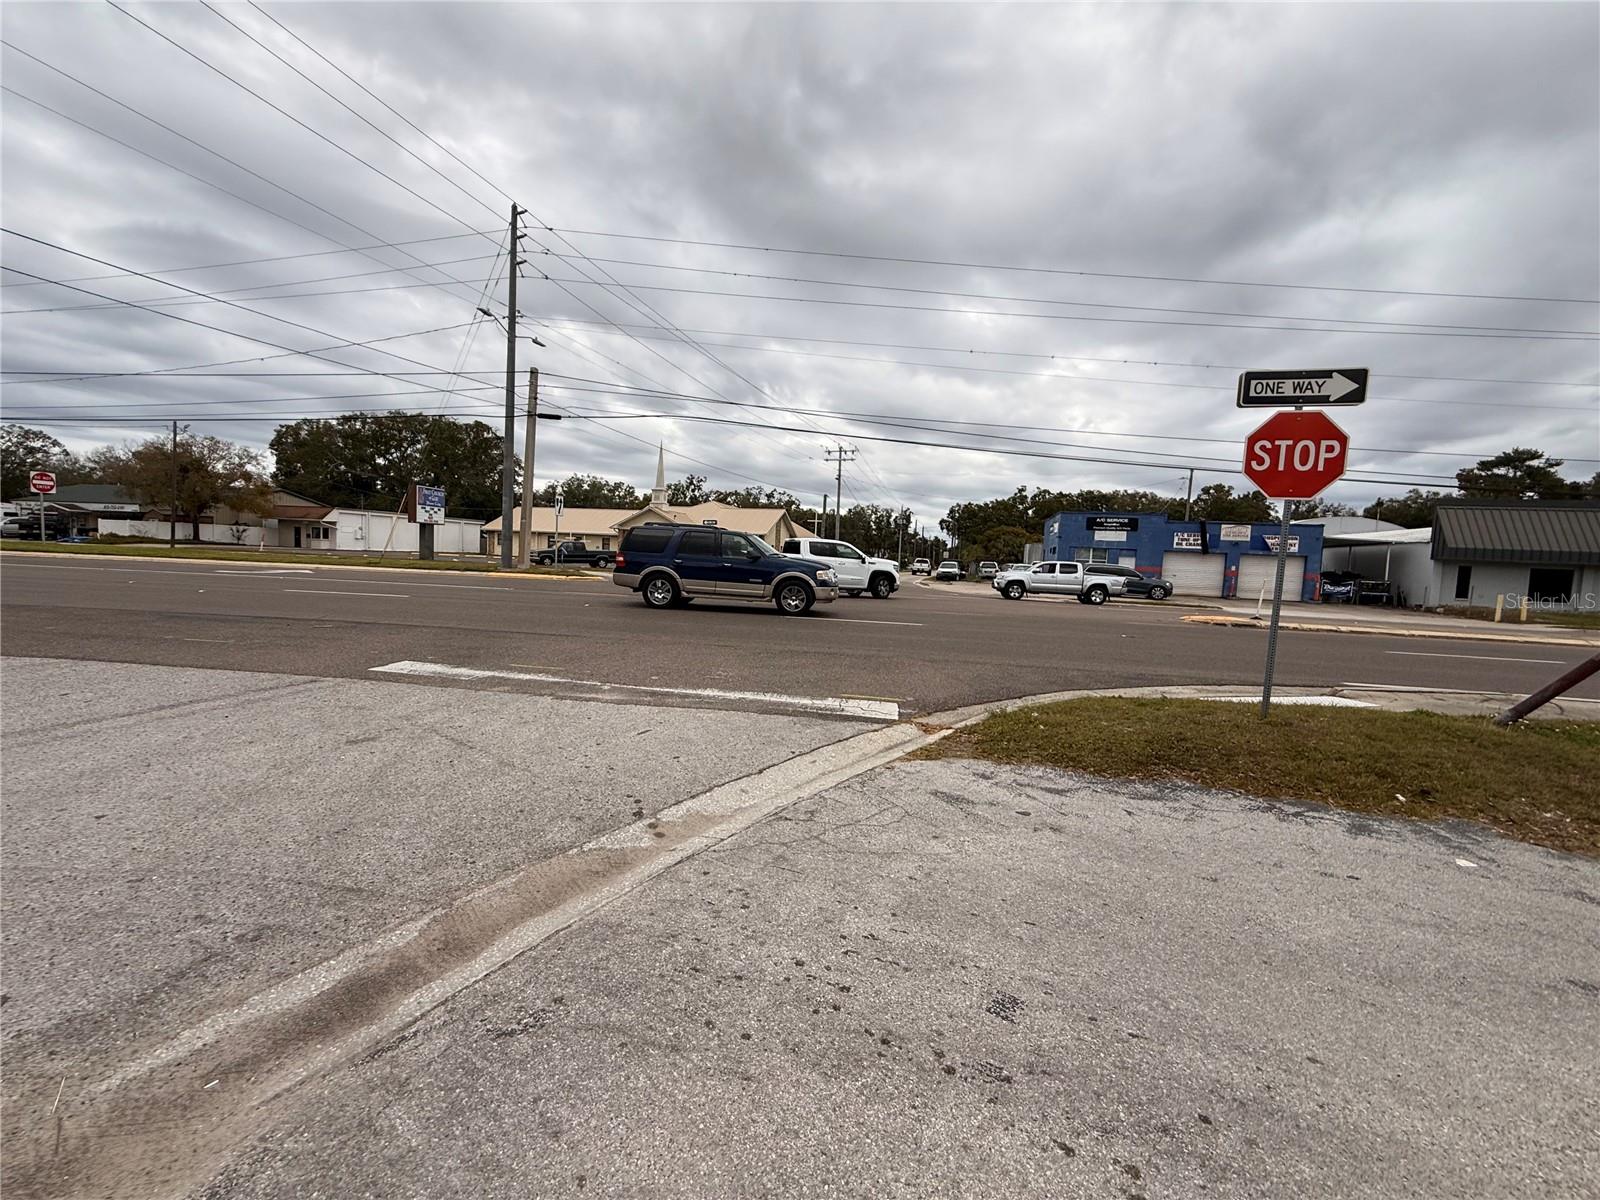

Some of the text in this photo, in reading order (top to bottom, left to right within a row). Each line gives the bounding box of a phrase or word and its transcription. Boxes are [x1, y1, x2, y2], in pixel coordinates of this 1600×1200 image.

[1253, 379, 1327, 395] ONE WAY
[1250, 439, 1341, 471] STOP
